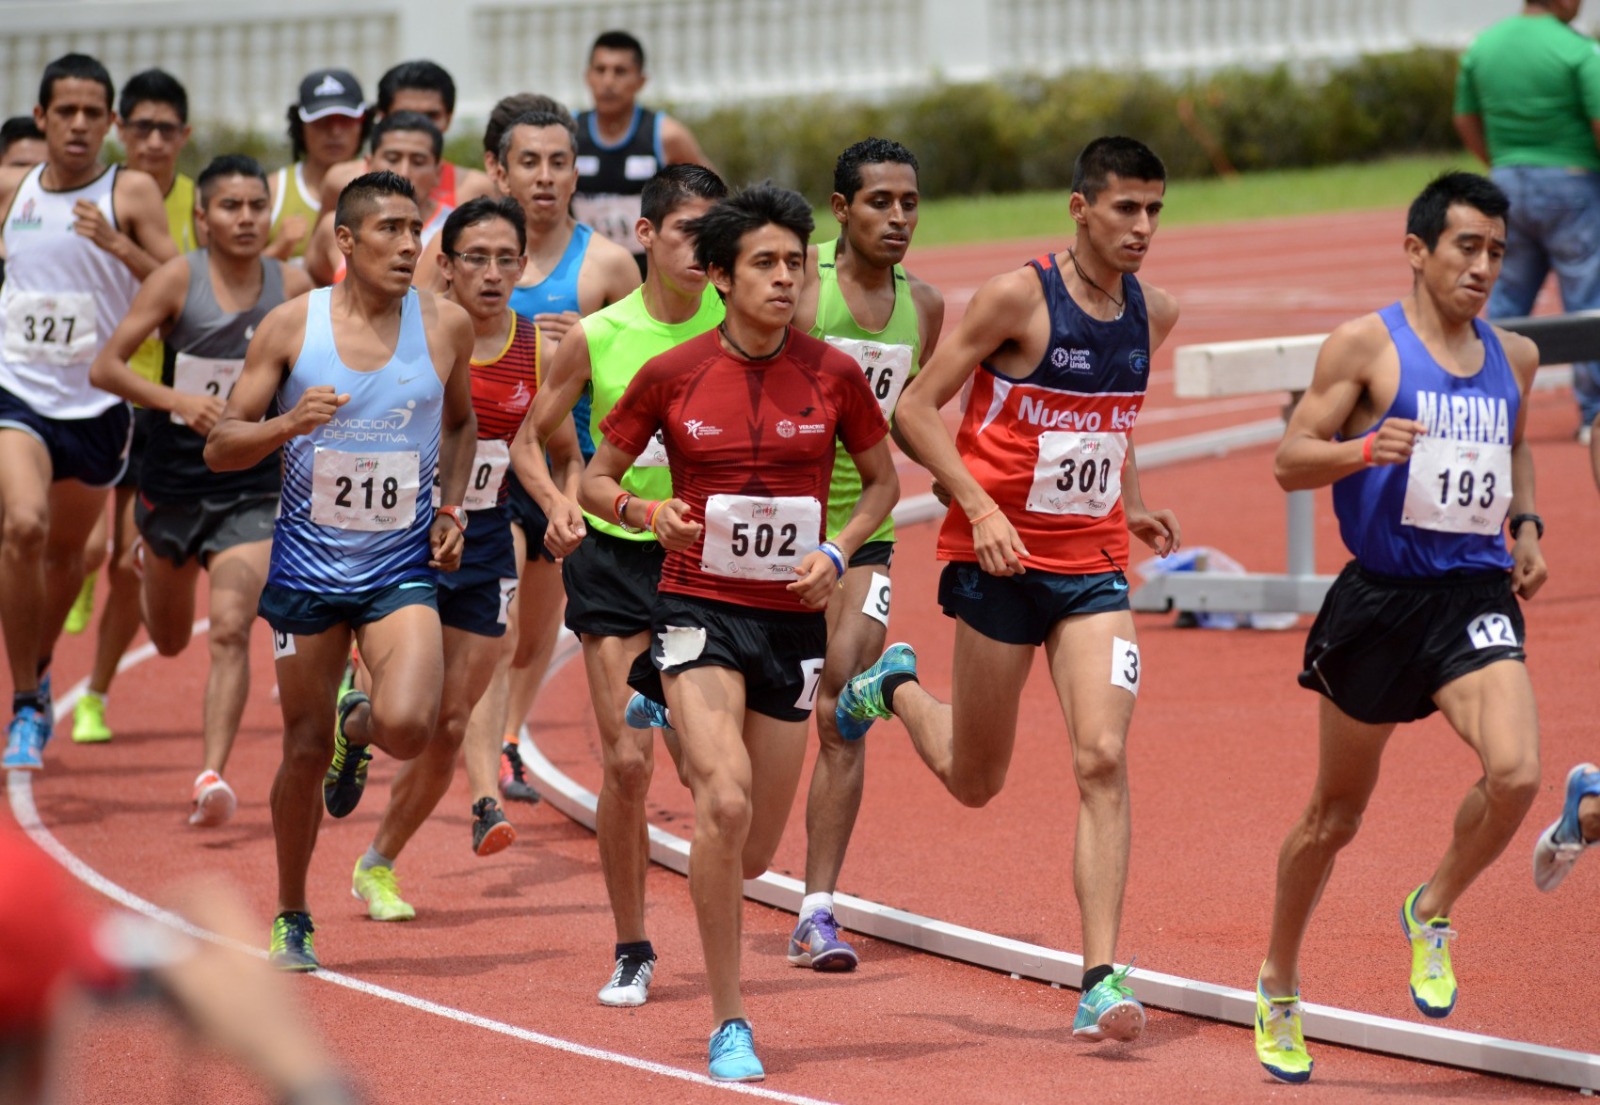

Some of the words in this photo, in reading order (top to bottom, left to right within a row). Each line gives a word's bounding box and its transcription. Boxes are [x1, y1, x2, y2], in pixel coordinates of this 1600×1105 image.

[24, 315, 76, 345] 327
[1070, 360, 1091, 370] Unido
[1018, 395, 1102, 431] Nuevo
[1416, 390, 1509, 445] MARINA
[323, 429, 409, 443] DEPORTIVA
[335, 476, 398, 509] 218
[1056, 458, 1111, 494] 300
[1438, 468, 1496, 509] 193
[731, 523, 797, 557] 502
[876, 585, 891, 616] 9
[1476, 616, 1514, 643] 12
[1123, 649, 1138, 685] 3
[808, 667, 824, 702] 7
